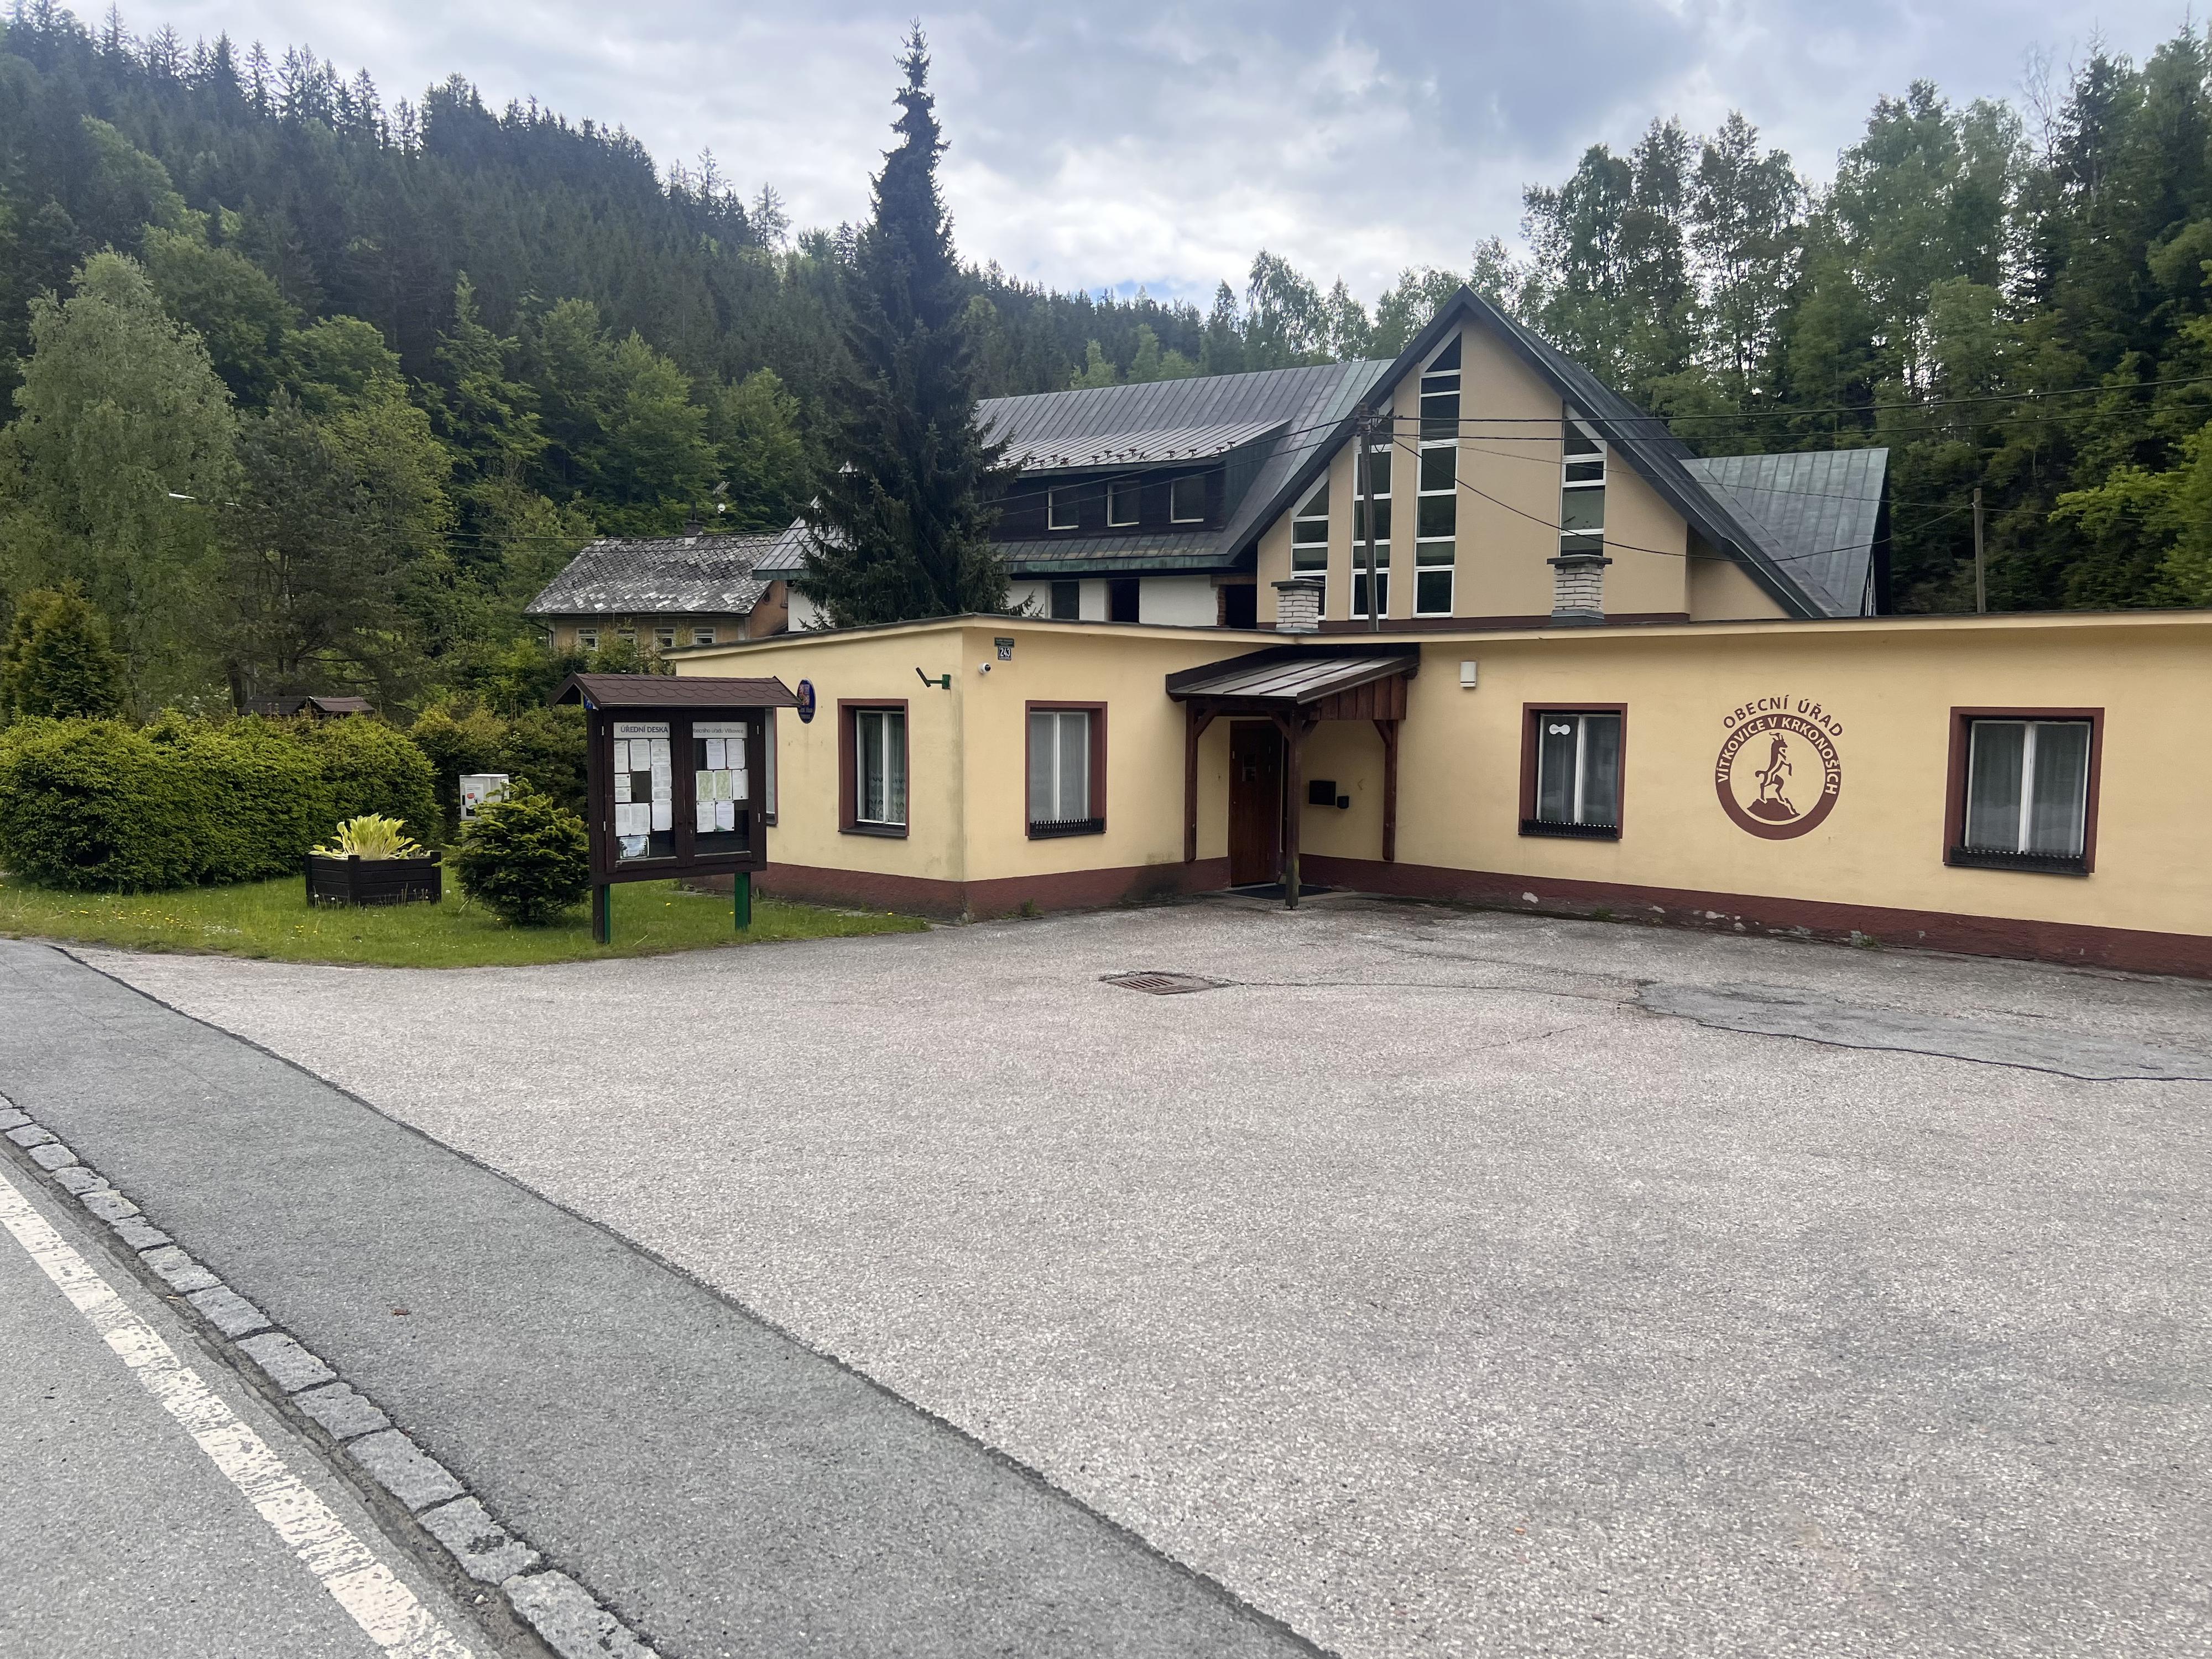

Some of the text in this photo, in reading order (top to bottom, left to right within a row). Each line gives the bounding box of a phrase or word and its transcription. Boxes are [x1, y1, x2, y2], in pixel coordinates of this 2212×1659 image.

[1000, 648, 1010, 657] 243
[1723, 695, 1843, 737] OBECNÍ ÚŘAD
[1716, 717, 1841, 795] VÍTKOVICE V KRKONOŠÍCH
